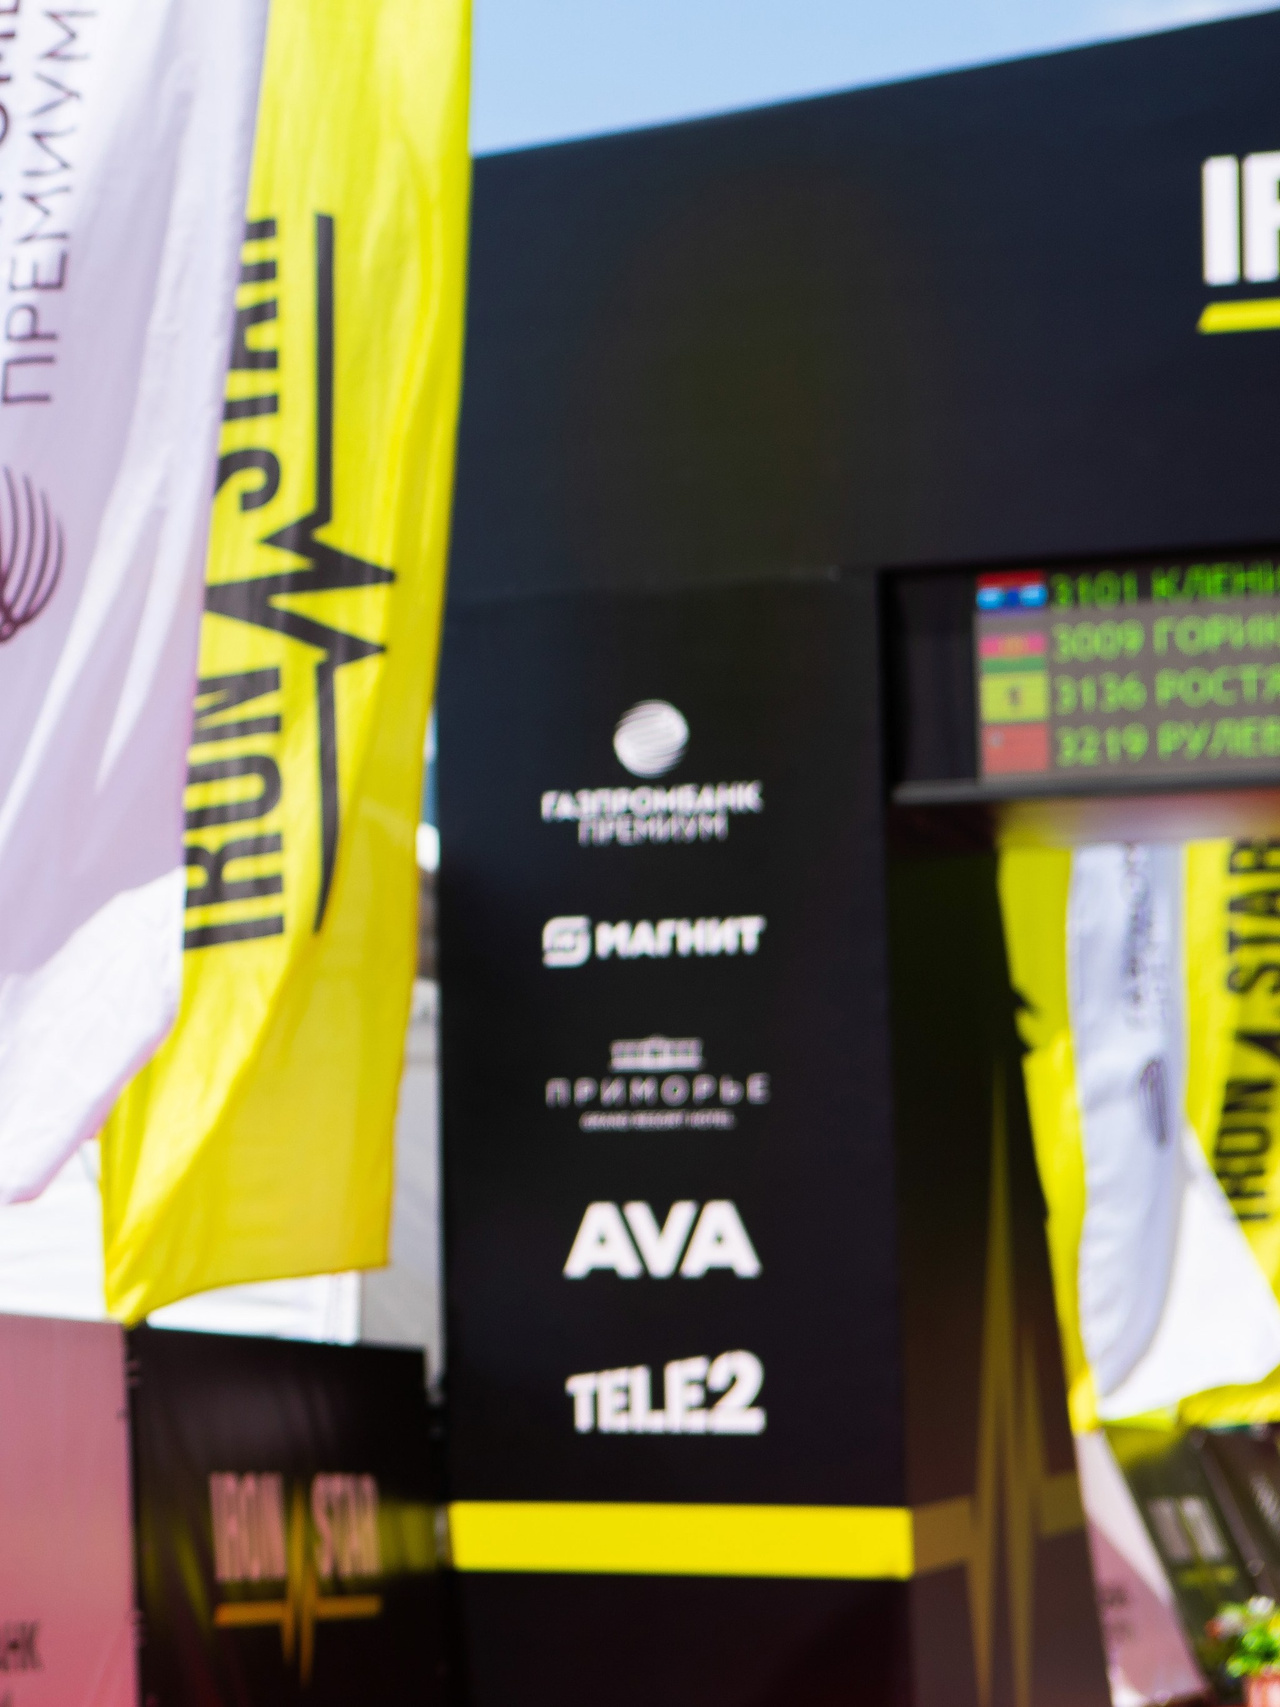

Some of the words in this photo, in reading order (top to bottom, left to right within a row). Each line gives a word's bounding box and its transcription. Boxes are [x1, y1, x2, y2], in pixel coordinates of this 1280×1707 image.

[0, 8, 98, 406] ПРЕМИУМ
[1050, 568, 1139, 614] 3101
[1051, 618, 1146, 664] 3009
[1053, 670, 1148, 716] 3136
[1054, 721, 1150, 768] 3219
[540, 780, 764, 822] ГАЗПРОМБАНК
[578, 813, 729, 847] ПРЕМИУМ
[595, 915, 766, 959] МАГНИТ
[545, 1072, 771, 1109] ПРИМОРЬЕ
[562, 1199, 763, 1280] AVA
[565, 1349, 766, 1436] TELE2
